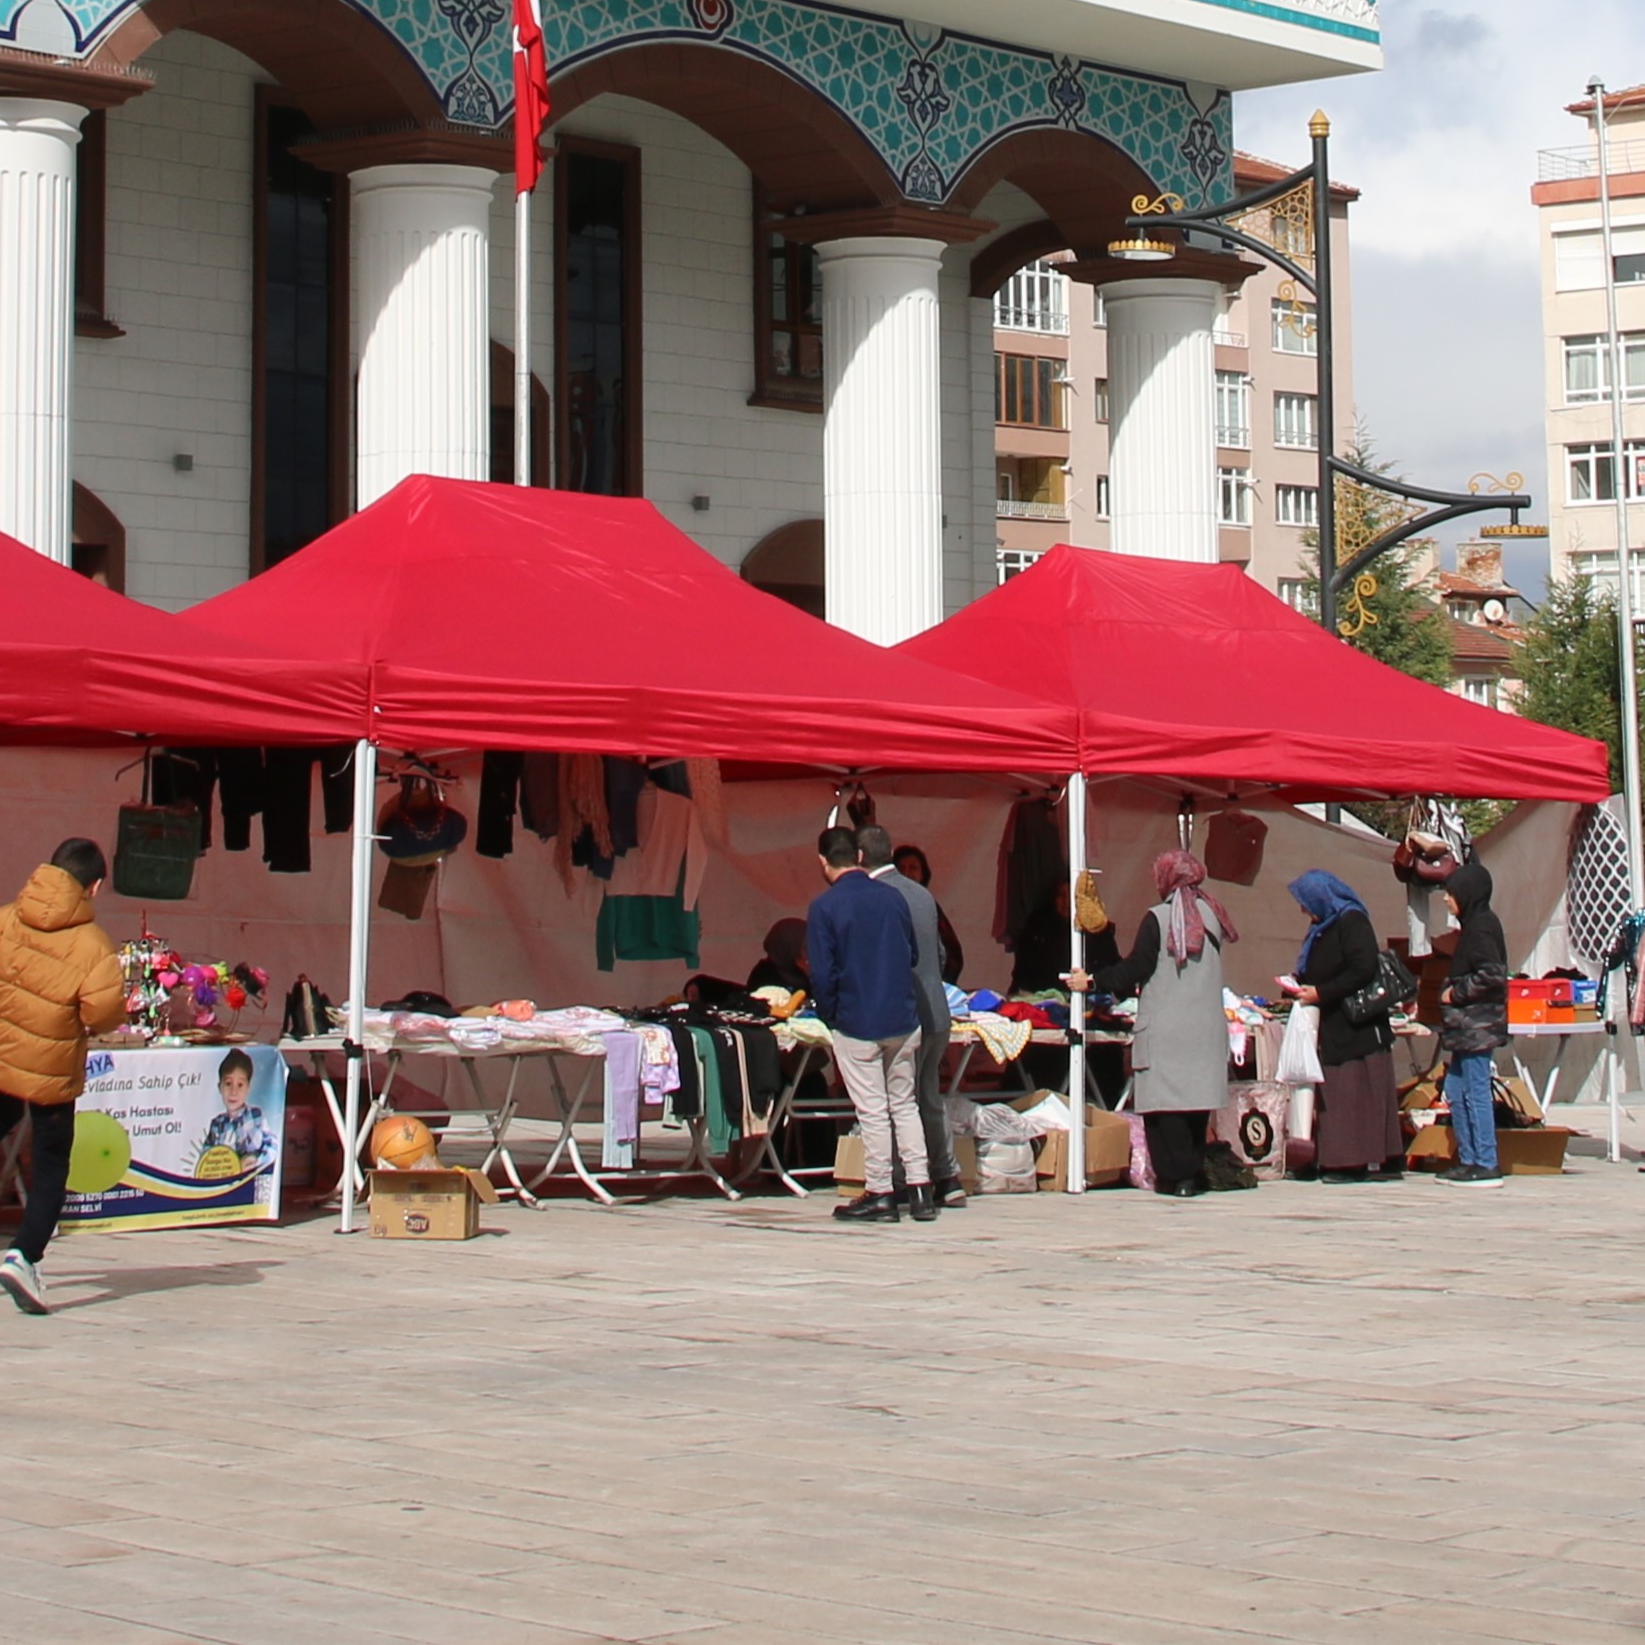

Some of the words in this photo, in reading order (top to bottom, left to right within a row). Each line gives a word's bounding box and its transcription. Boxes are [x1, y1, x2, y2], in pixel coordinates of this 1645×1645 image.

[137, 1075, 174, 1090] Sahip
[177, 1071, 202, 1089] Çık!
[129, 1106, 174, 1118] Hastası
[132, 1124, 162, 1137] Umut
